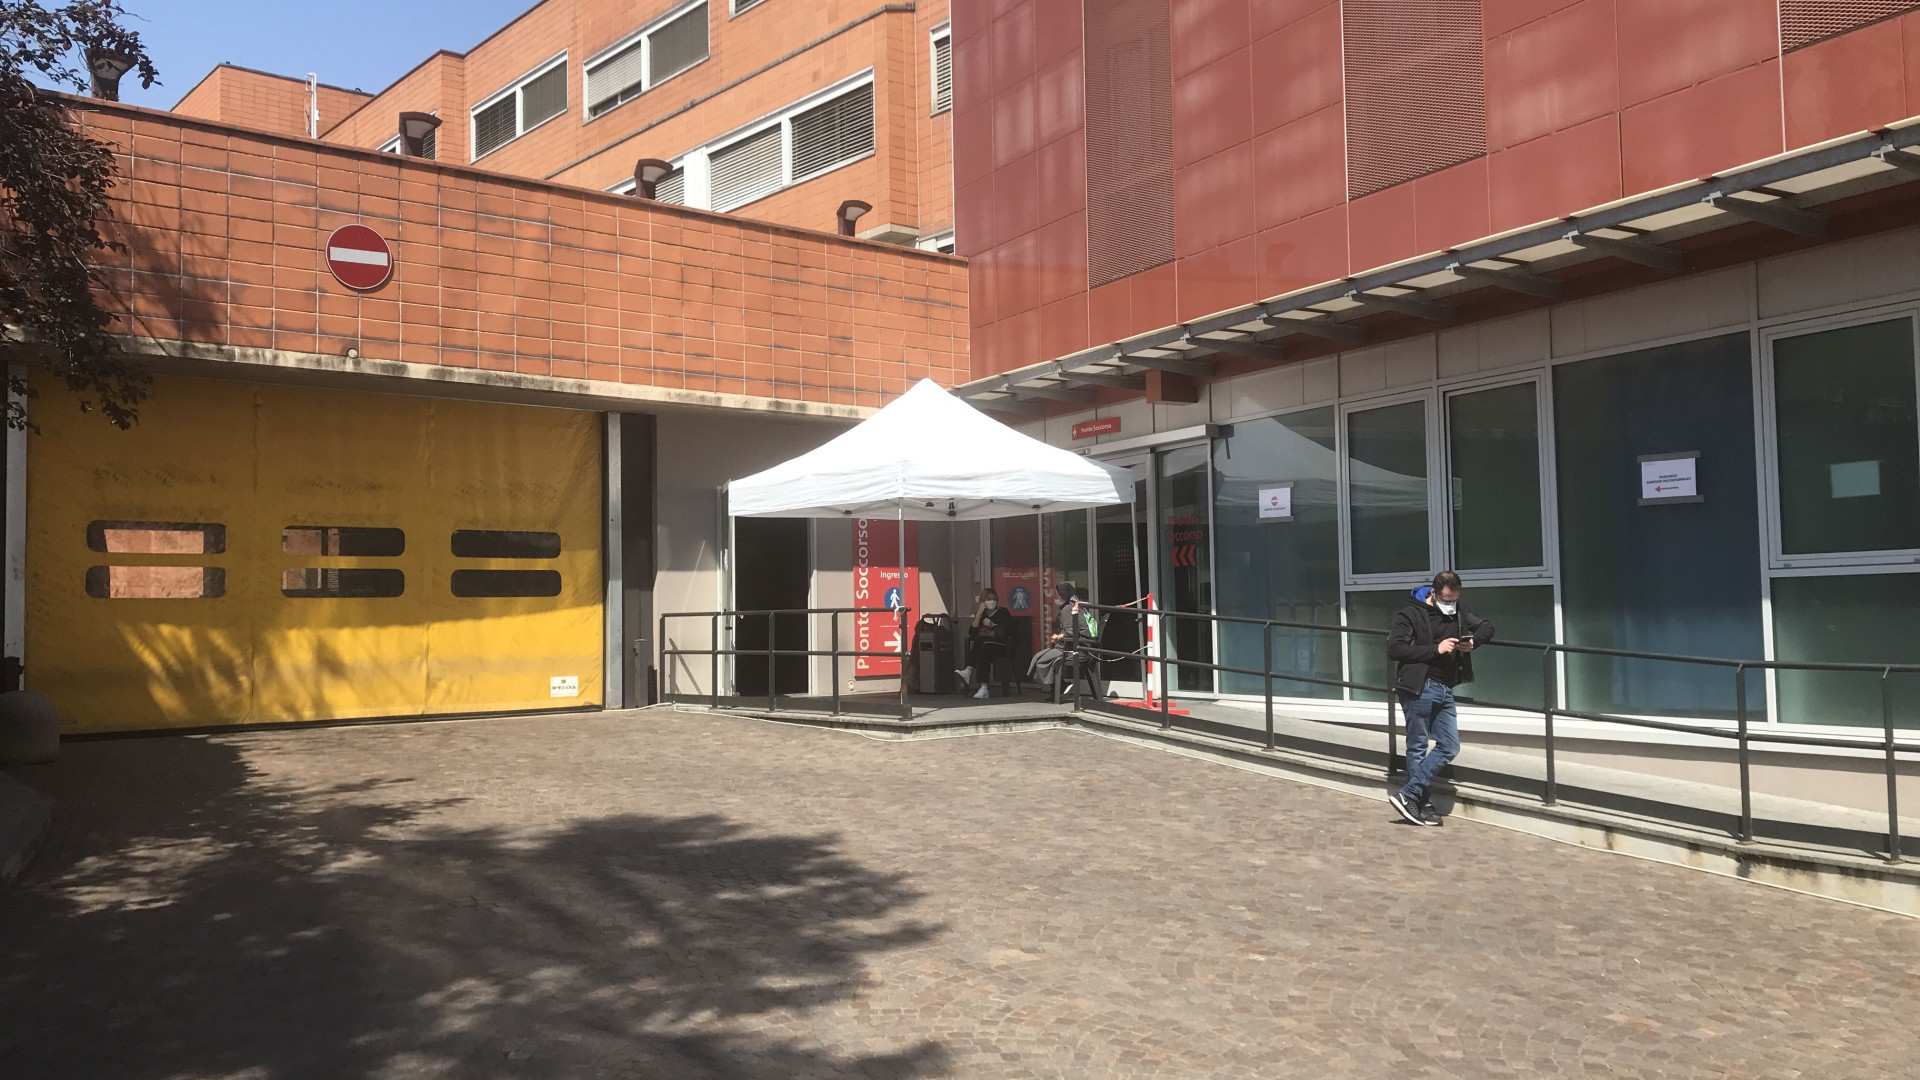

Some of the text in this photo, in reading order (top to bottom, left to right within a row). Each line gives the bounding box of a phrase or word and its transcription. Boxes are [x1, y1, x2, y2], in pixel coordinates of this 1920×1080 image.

[856, 518, 869, 670] Ponto Soccorso
[880, 570, 909, 581] Ingreso
